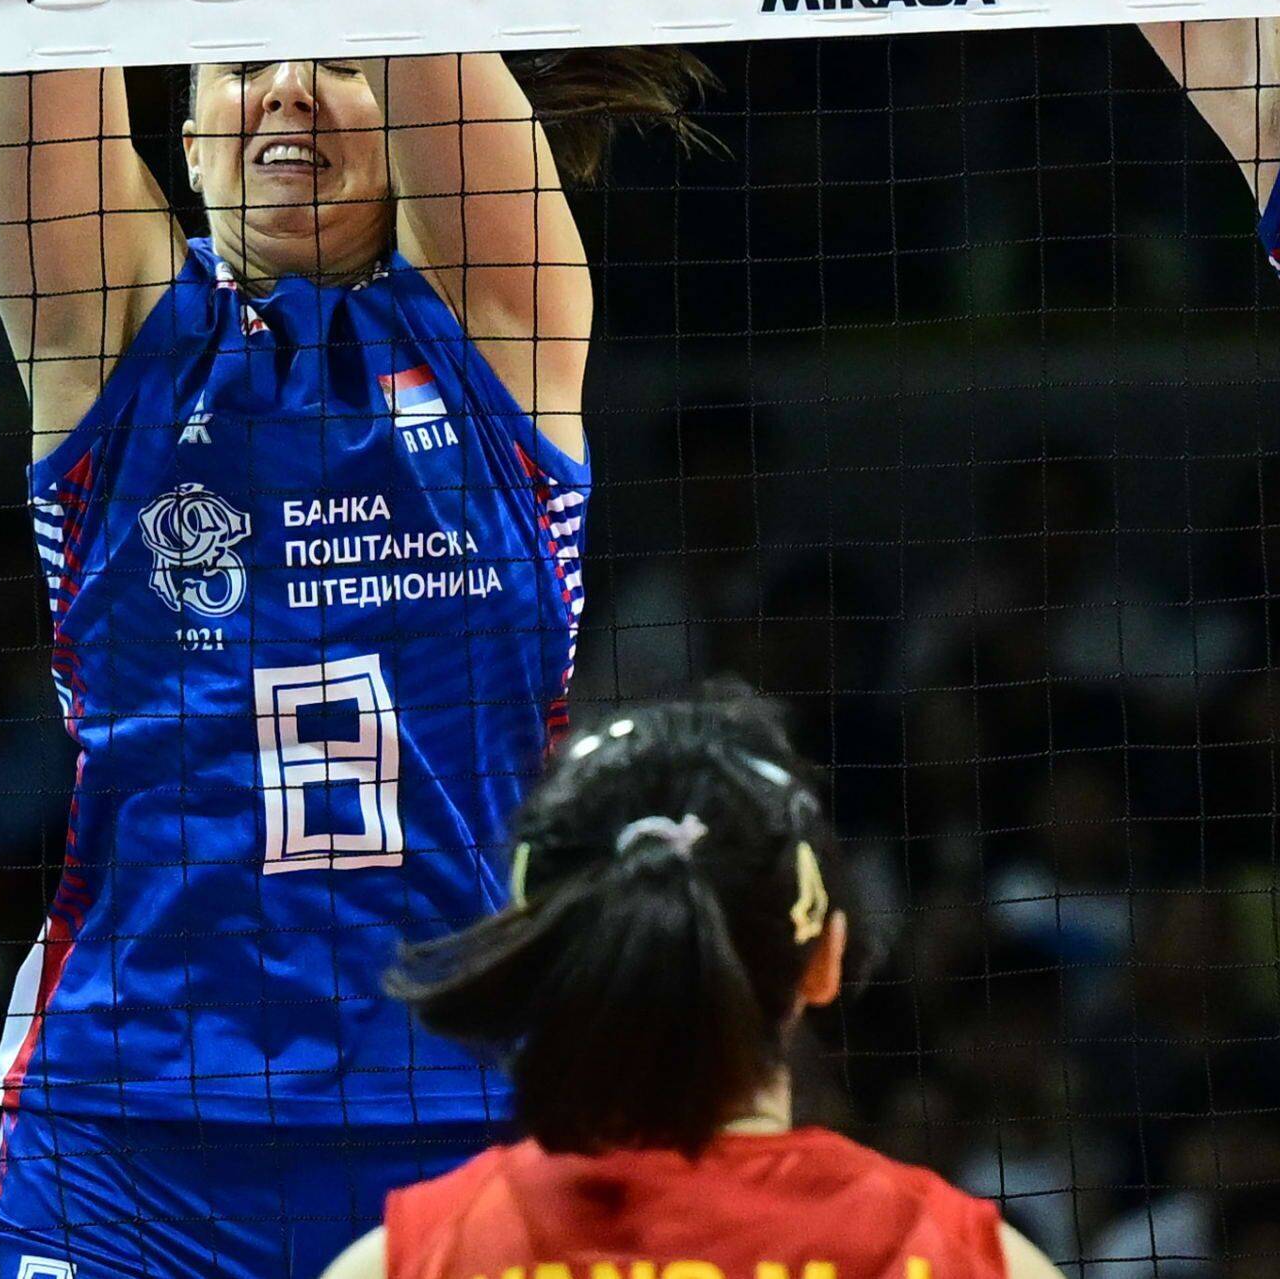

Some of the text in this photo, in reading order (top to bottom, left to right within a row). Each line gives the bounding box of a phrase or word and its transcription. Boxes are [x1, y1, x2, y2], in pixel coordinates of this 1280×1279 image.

[402, 422, 459, 454] RBIA
[283, 495, 391, 527] БАНКА
[285, 529, 479, 567] ПОШТАНСКА
[287, 566, 503, 609] ШТЕДИОНИЦА
[175, 628, 225, 651] 1921
[253, 653, 405, 876] 8
